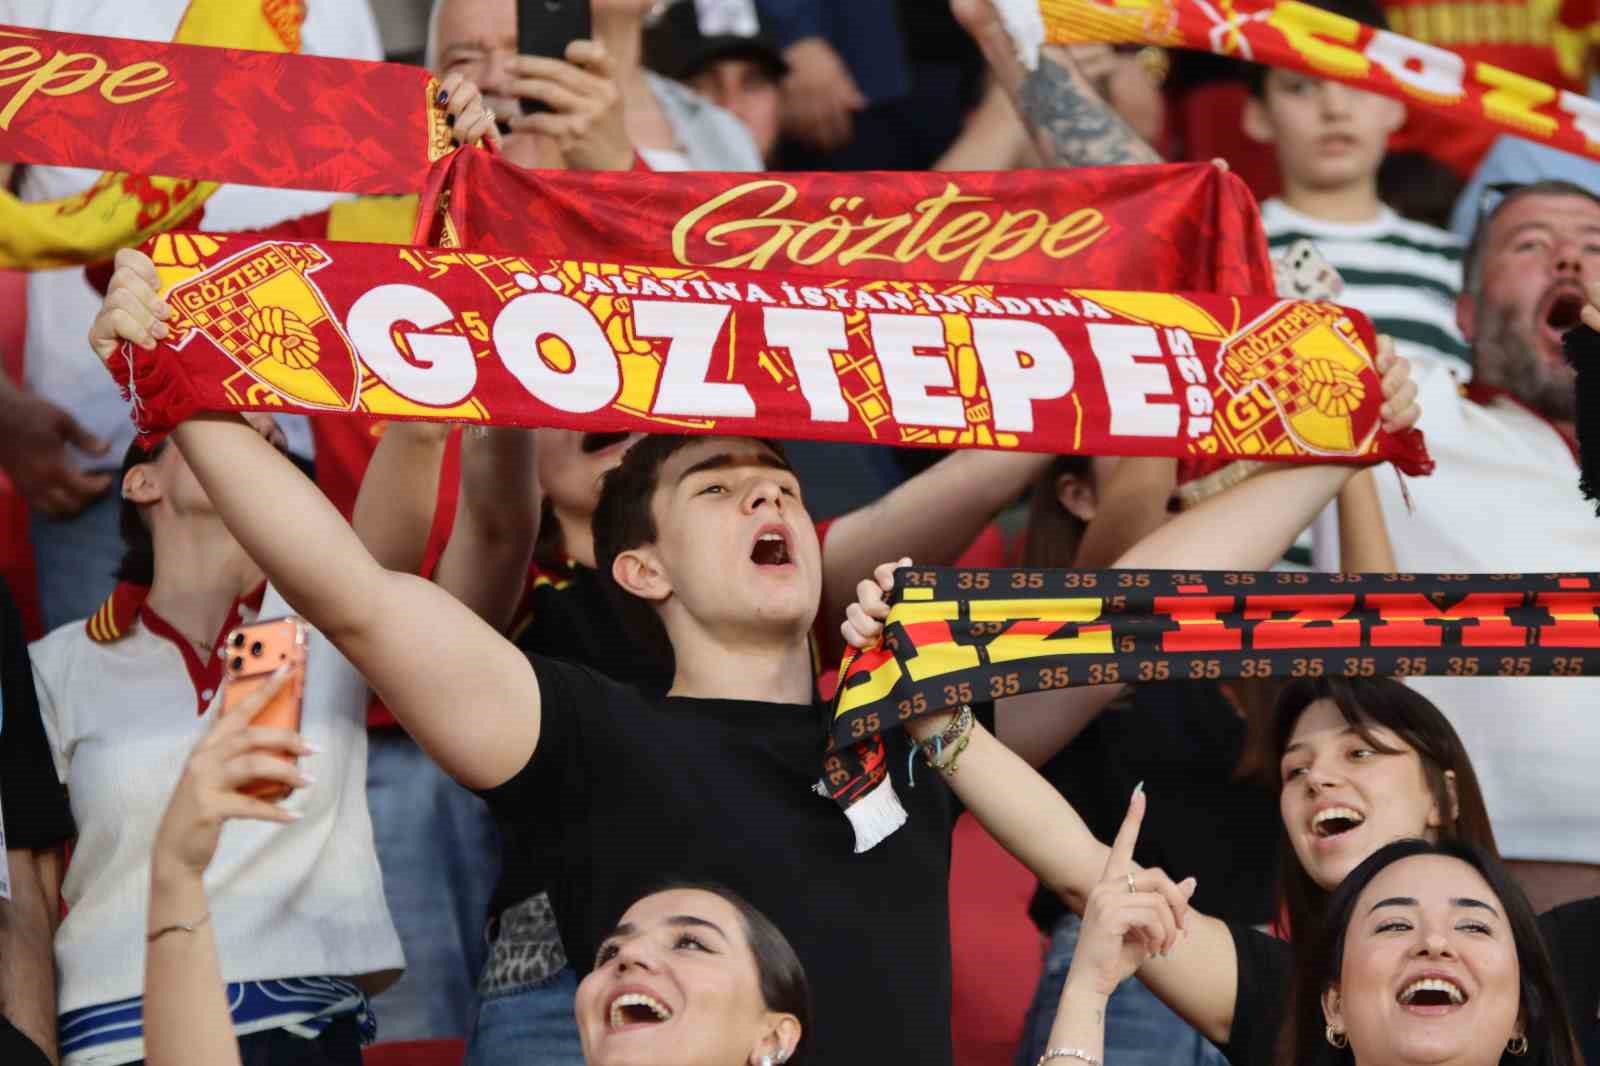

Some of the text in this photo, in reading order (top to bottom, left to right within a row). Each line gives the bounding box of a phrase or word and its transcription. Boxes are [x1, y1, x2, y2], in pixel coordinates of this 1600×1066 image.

[671, 180, 1110, 281] Göztepe
[183, 251, 287, 310] GÖZTEPE
[582, 271, 1113, 320] ALAYINA İSYAN İNADINA
[345, 270, 1184, 438] GÖZTEPE
[1238, 305, 1318, 365] GÖZTEPE
[1163, 326, 1215, 439] 1925
[957, 572, 991, 589] 35
[1011, 572, 1044, 588] 35
[1064, 573, 1097, 588] 35
[1118, 573, 1150, 587] 35
[1224, 573, 1256, 585] 35
[850, 656, 1585, 738] 35 35 35 35 35 35 35 35 35 35 35 35 35 35 35
